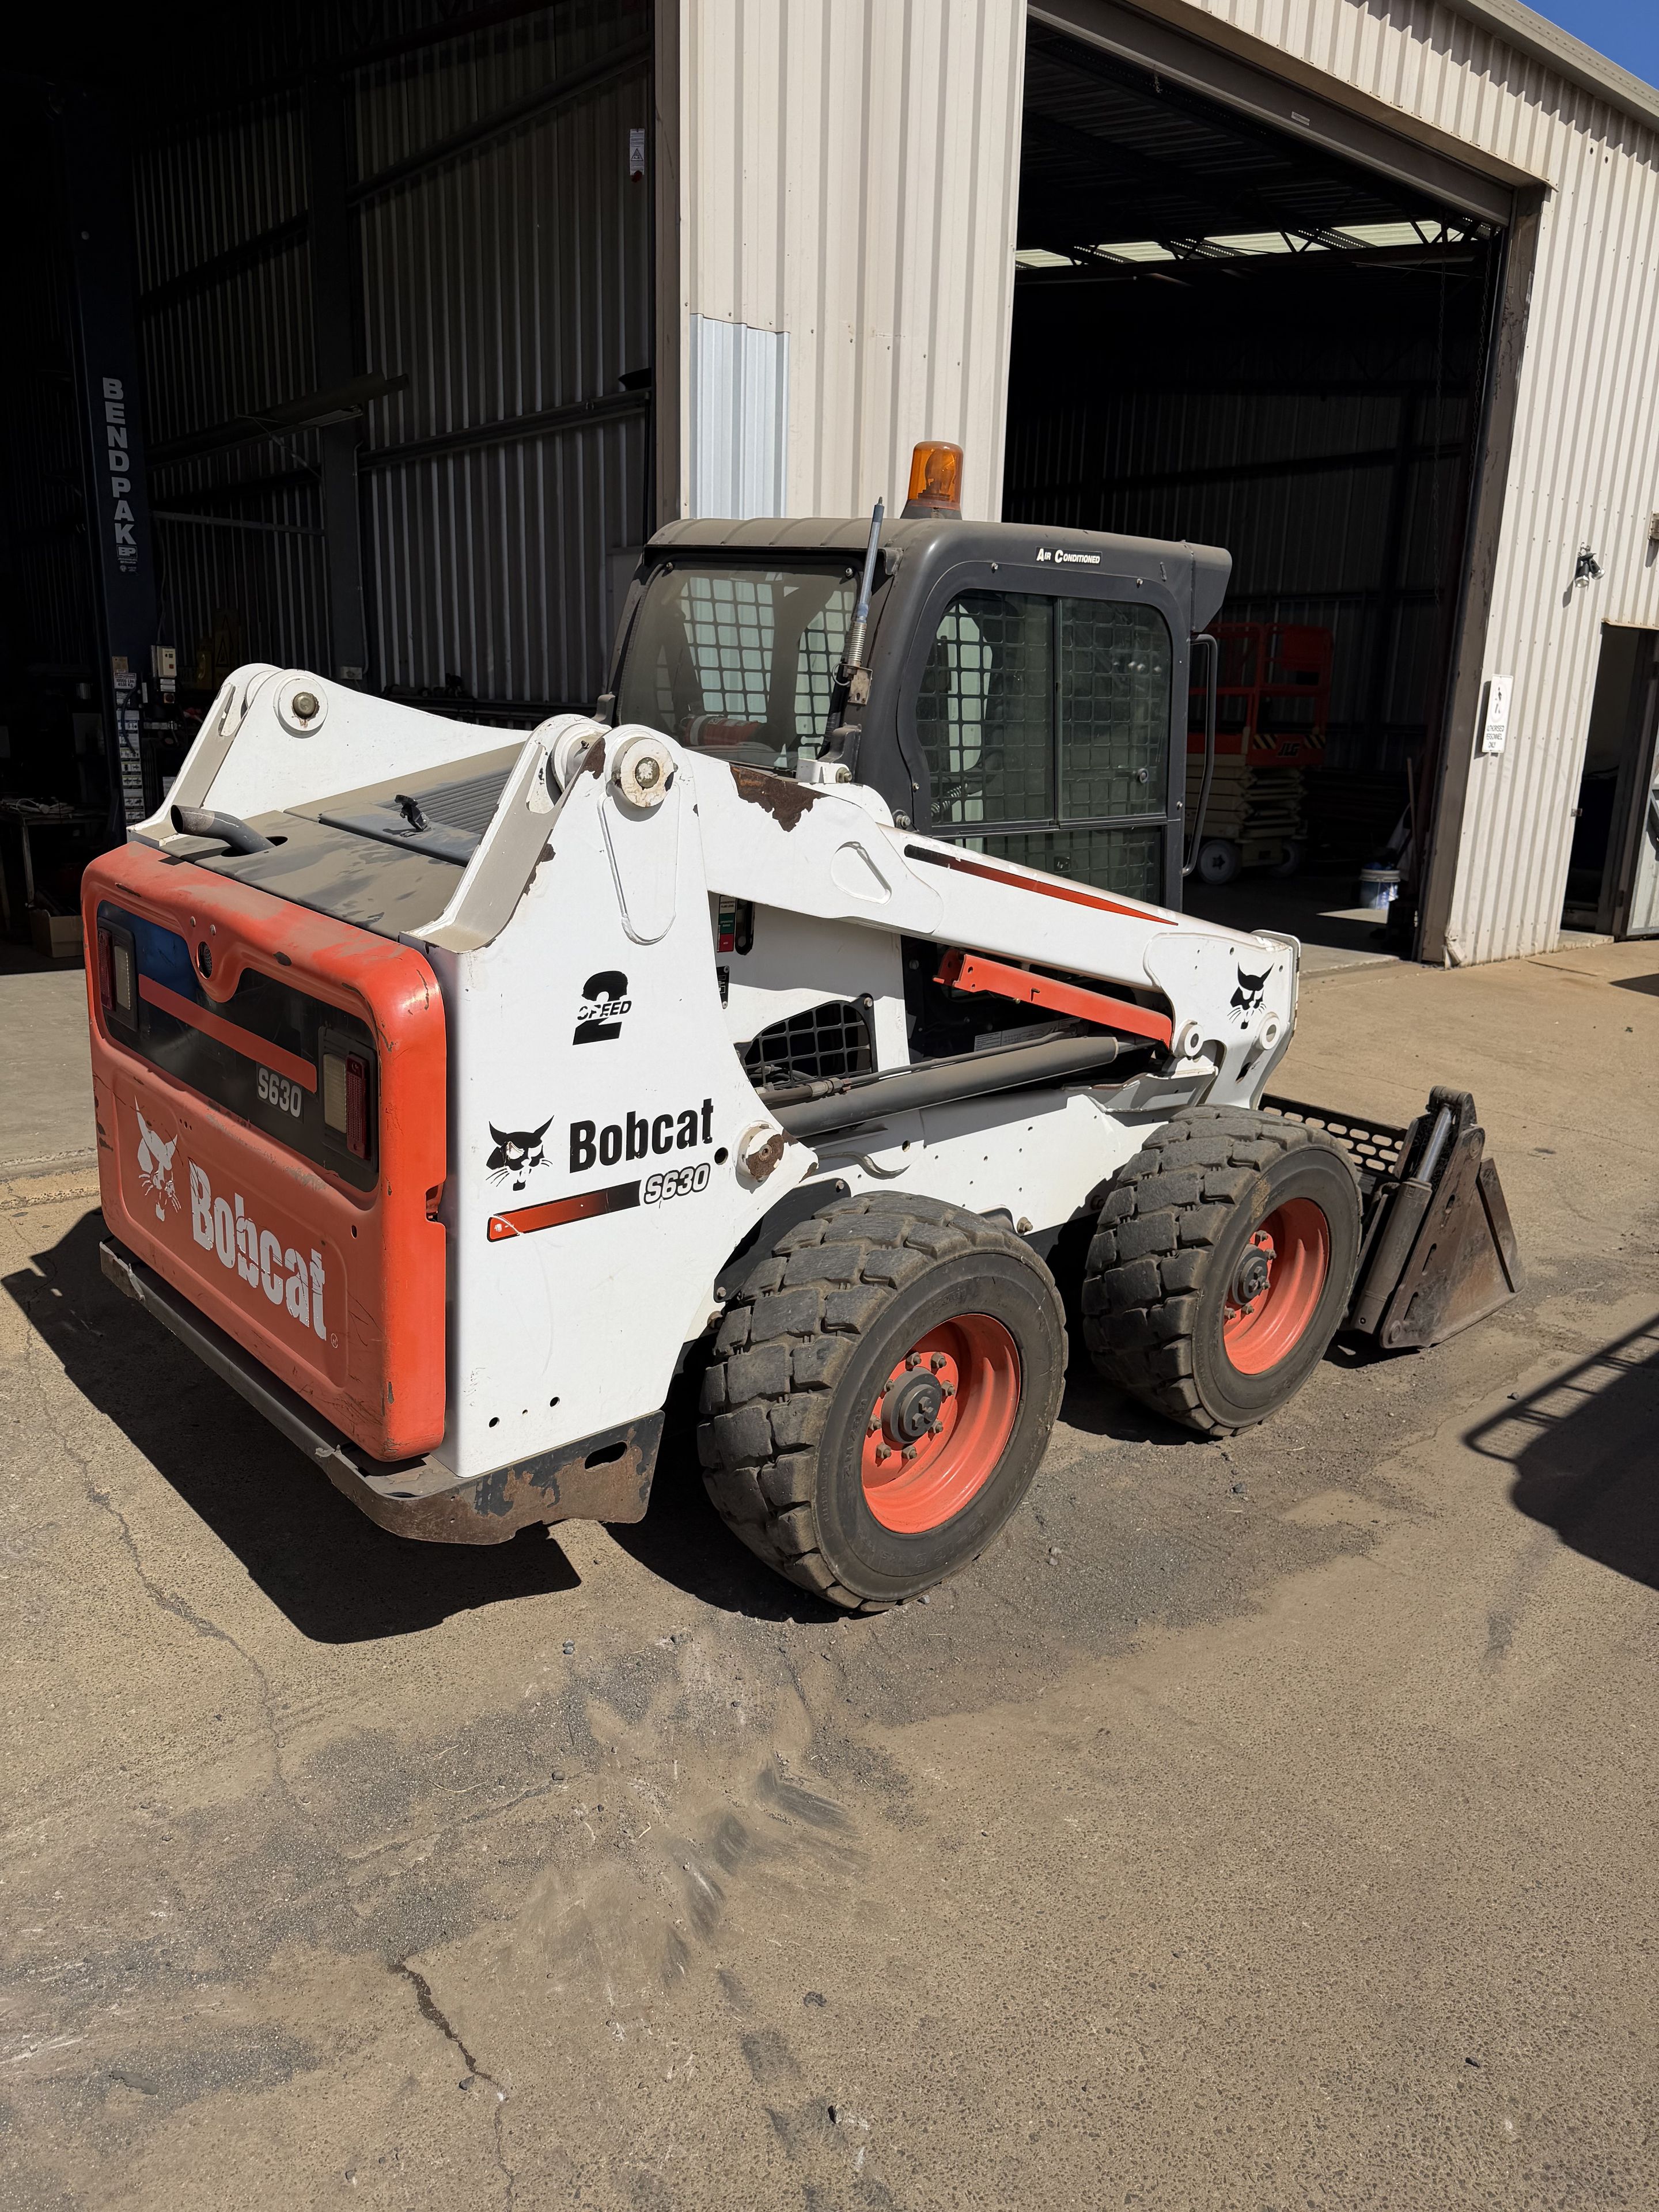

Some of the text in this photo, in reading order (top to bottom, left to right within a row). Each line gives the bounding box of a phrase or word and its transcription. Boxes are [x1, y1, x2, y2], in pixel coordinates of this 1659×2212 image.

[103, 377, 137, 545] BENDPAK
[258, 1067, 302, 1118] S630
[569, 1098, 714, 1173] Bobcat
[643, 1162, 711, 1205] S630
[188, 1158, 327, 1342] Bobcat
